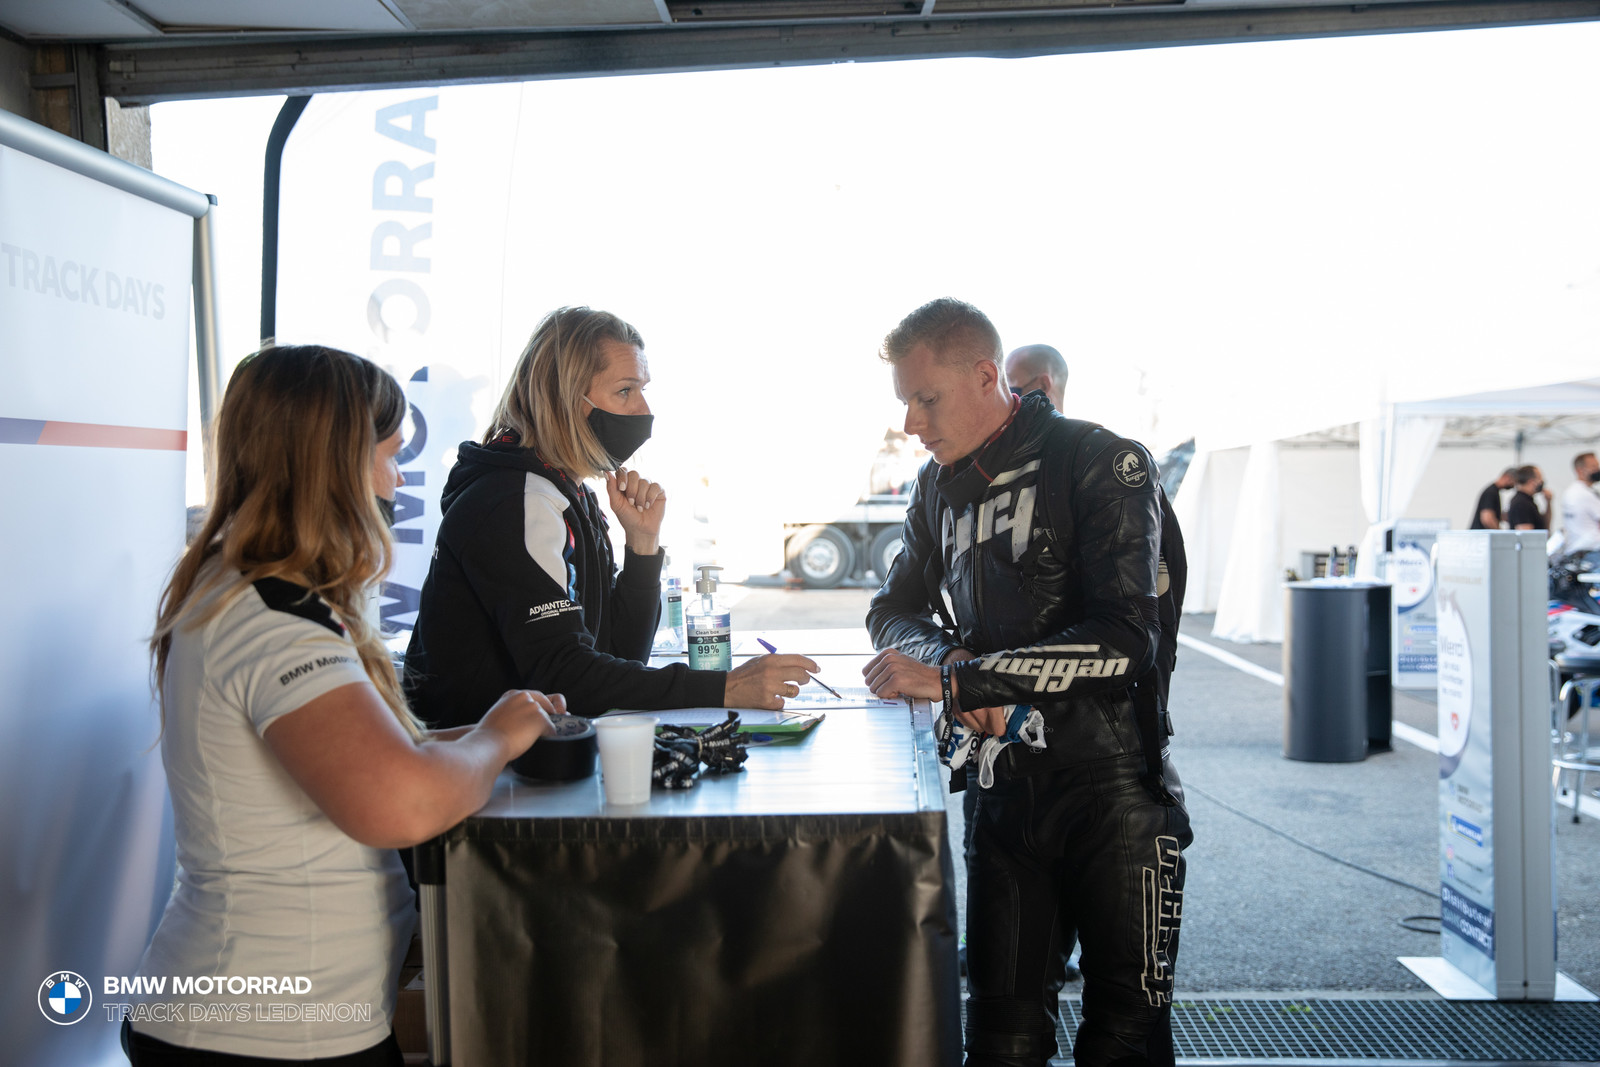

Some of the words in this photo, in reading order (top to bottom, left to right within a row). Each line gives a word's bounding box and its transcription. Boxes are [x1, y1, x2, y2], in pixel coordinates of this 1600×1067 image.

[1, 242, 101, 306] TRACK
[105, 270, 165, 320] DAYS
[529, 600, 571, 616] ADVANTEC
[697, 645, 720, 654] 99%
[280, 662, 314, 686] BMW
[709, 738, 731, 748] BMW
